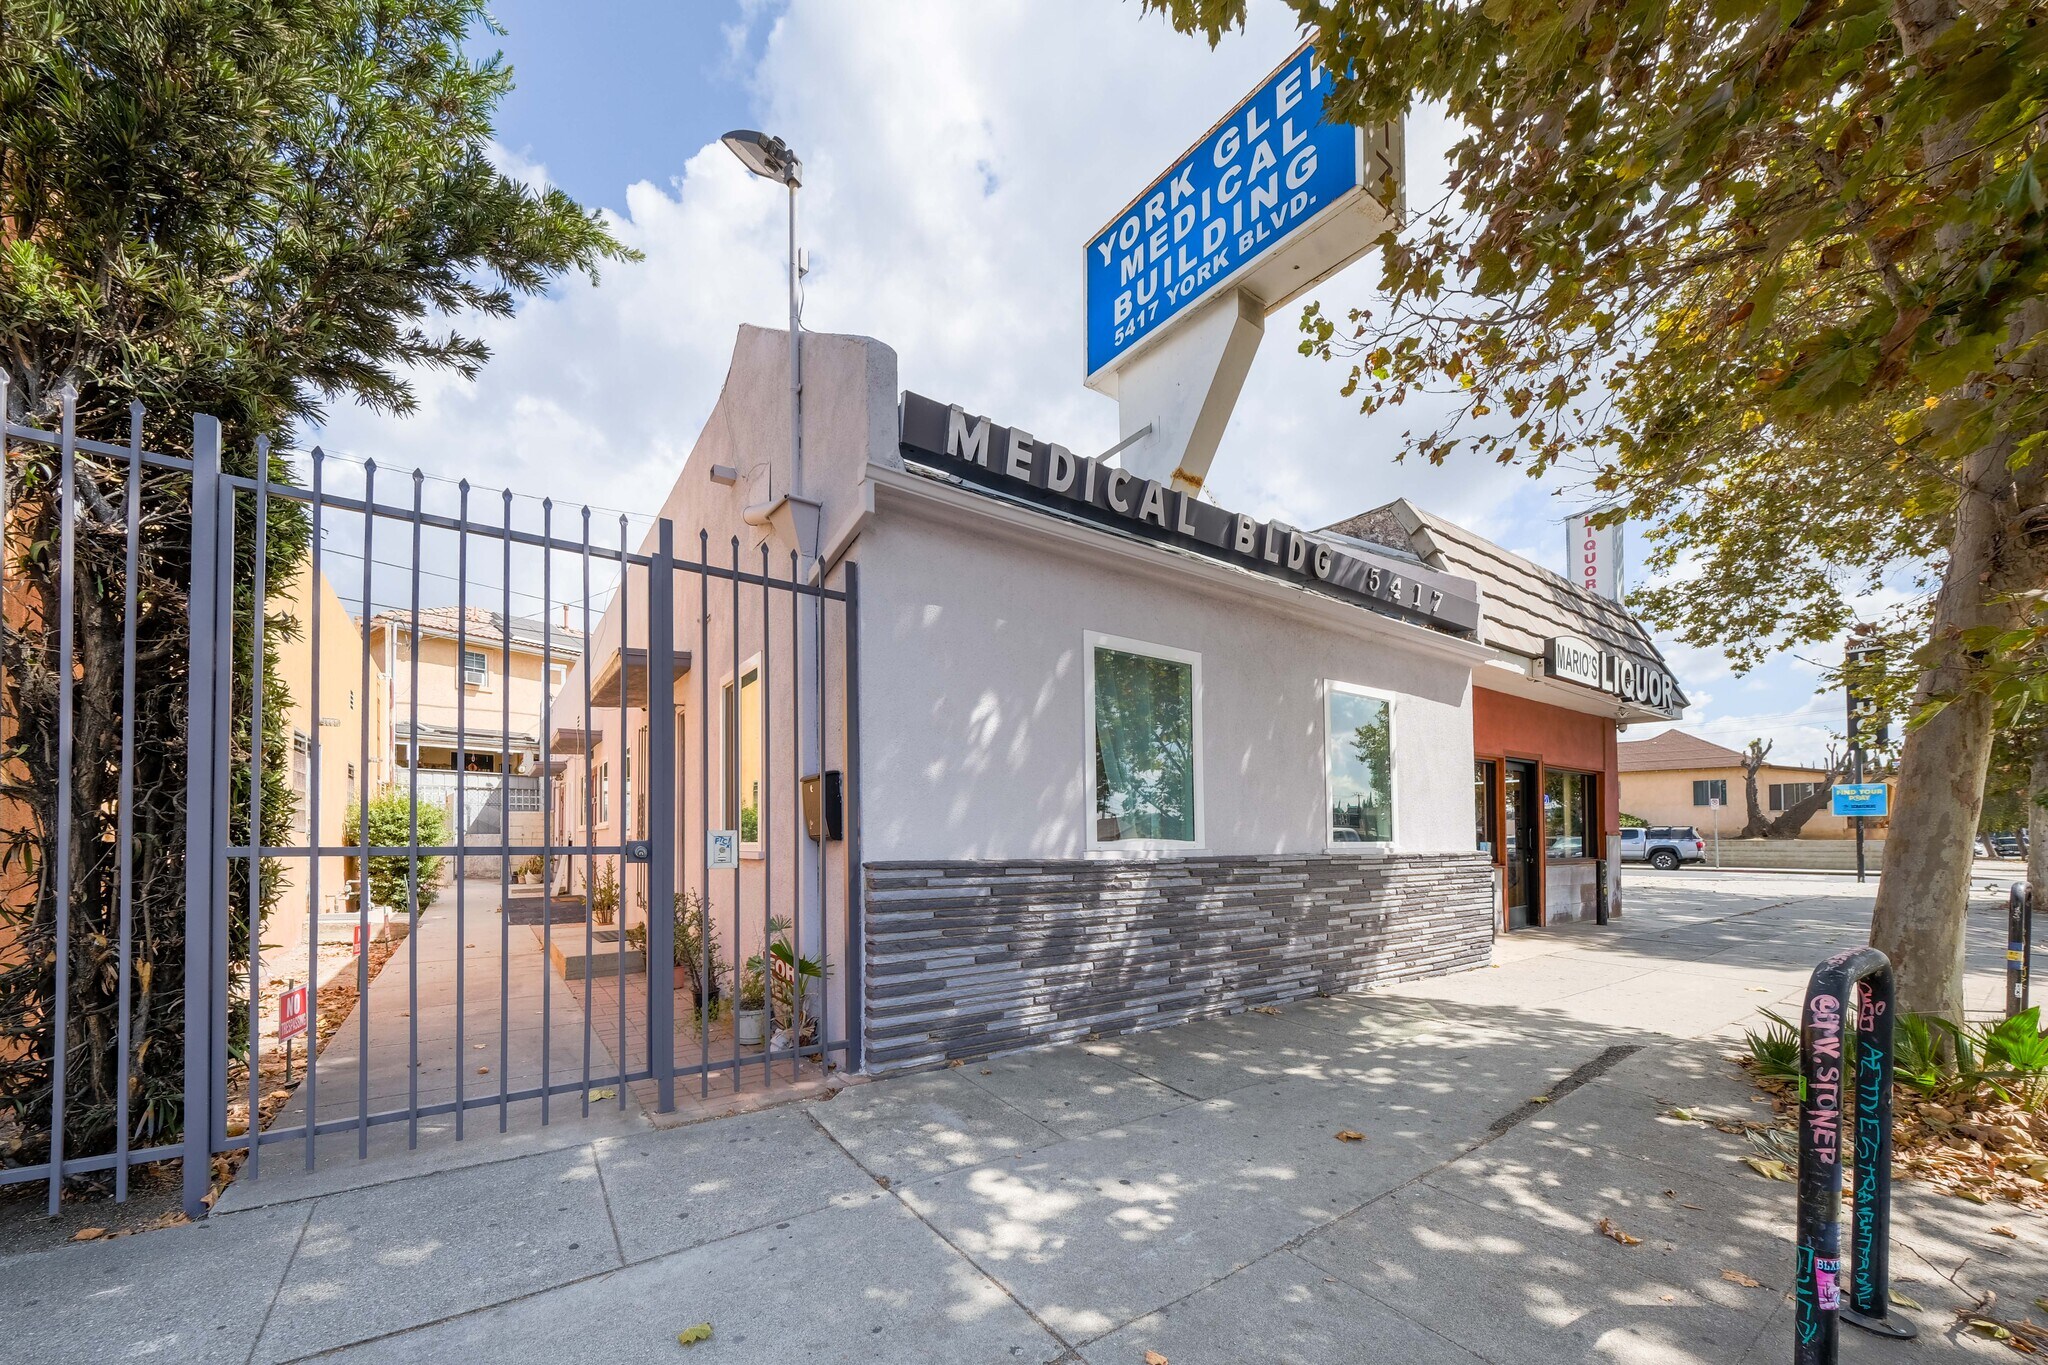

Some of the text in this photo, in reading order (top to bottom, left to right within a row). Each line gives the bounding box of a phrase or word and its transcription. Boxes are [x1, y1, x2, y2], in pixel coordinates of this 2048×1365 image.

[1098, 162, 1195, 267] YORK
[1114, 144, 1318, 327] BUILDING
[1114, 191, 1318, 347] 5417 YORK BLVD.
[1120, 118, 1308, 287] MEDICAL
[946, 406, 1444, 612] MEDICAL BLDG 5417
[1556, 644, 1674, 709] MARIO'S LIQUOR
[286, 993, 301, 1018] NO
